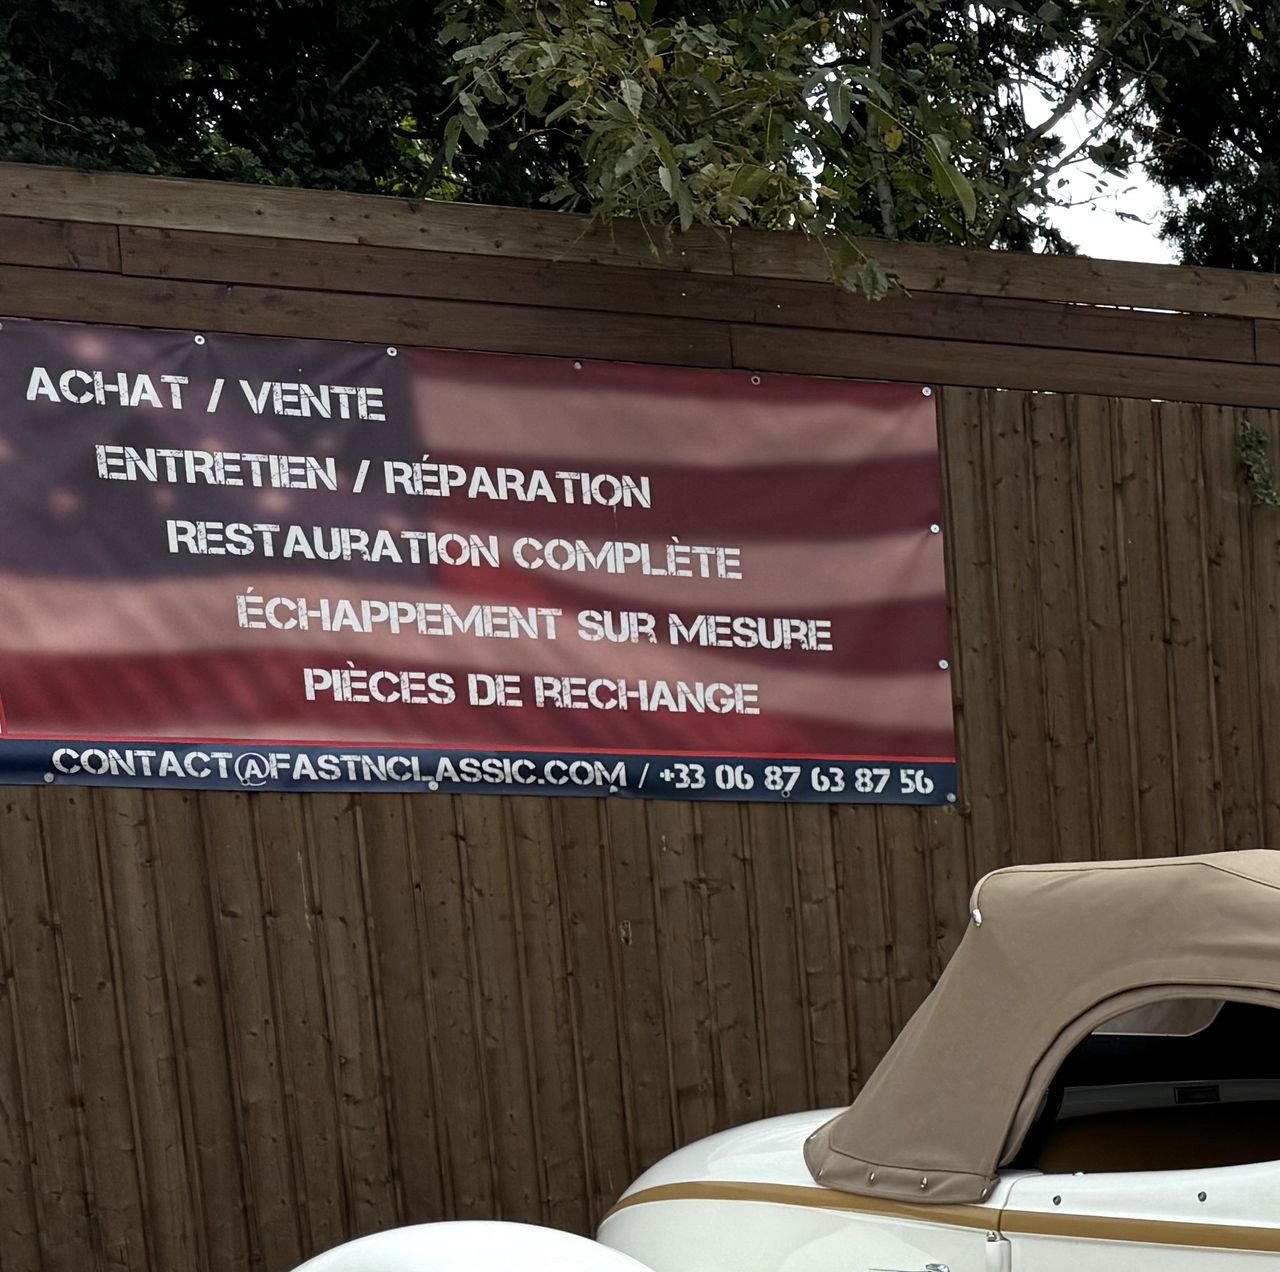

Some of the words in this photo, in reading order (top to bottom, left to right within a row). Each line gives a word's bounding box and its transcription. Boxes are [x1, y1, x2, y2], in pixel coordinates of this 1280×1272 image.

[26, 366, 189, 410] ACHAT
[206, 378, 225, 413] /
[239, 378, 386, 422] VENTE
[95, 444, 338, 491] ENTRETIEN
[352, 459, 371, 493] /
[383, 454, 651, 508] RÉPARATION
[166, 520, 500, 568] RESTAURATION
[512, 536, 743, 580] COMPLÈTE
[236, 586, 562, 640] ÉCHAPPEMENT
[577, 610, 657, 644] SUR
[668, 613, 833, 651] MESURE
[303, 661, 455, 706] PIÈCES
[467, 673, 523, 707] DE
[534, 676, 760, 715] RECHANGE
[52, 748, 627, 788] CONTACT@FASTNCLASSIC.COM
[638, 763, 650, 789] /
[659, 763, 706, 790] +33
[716, 764, 754, 790] 06
[764, 766, 800, 793] 87
[811, 767, 846, 793] 63
[854, 768, 891, 794] 87
[900, 769, 934, 795] 56
